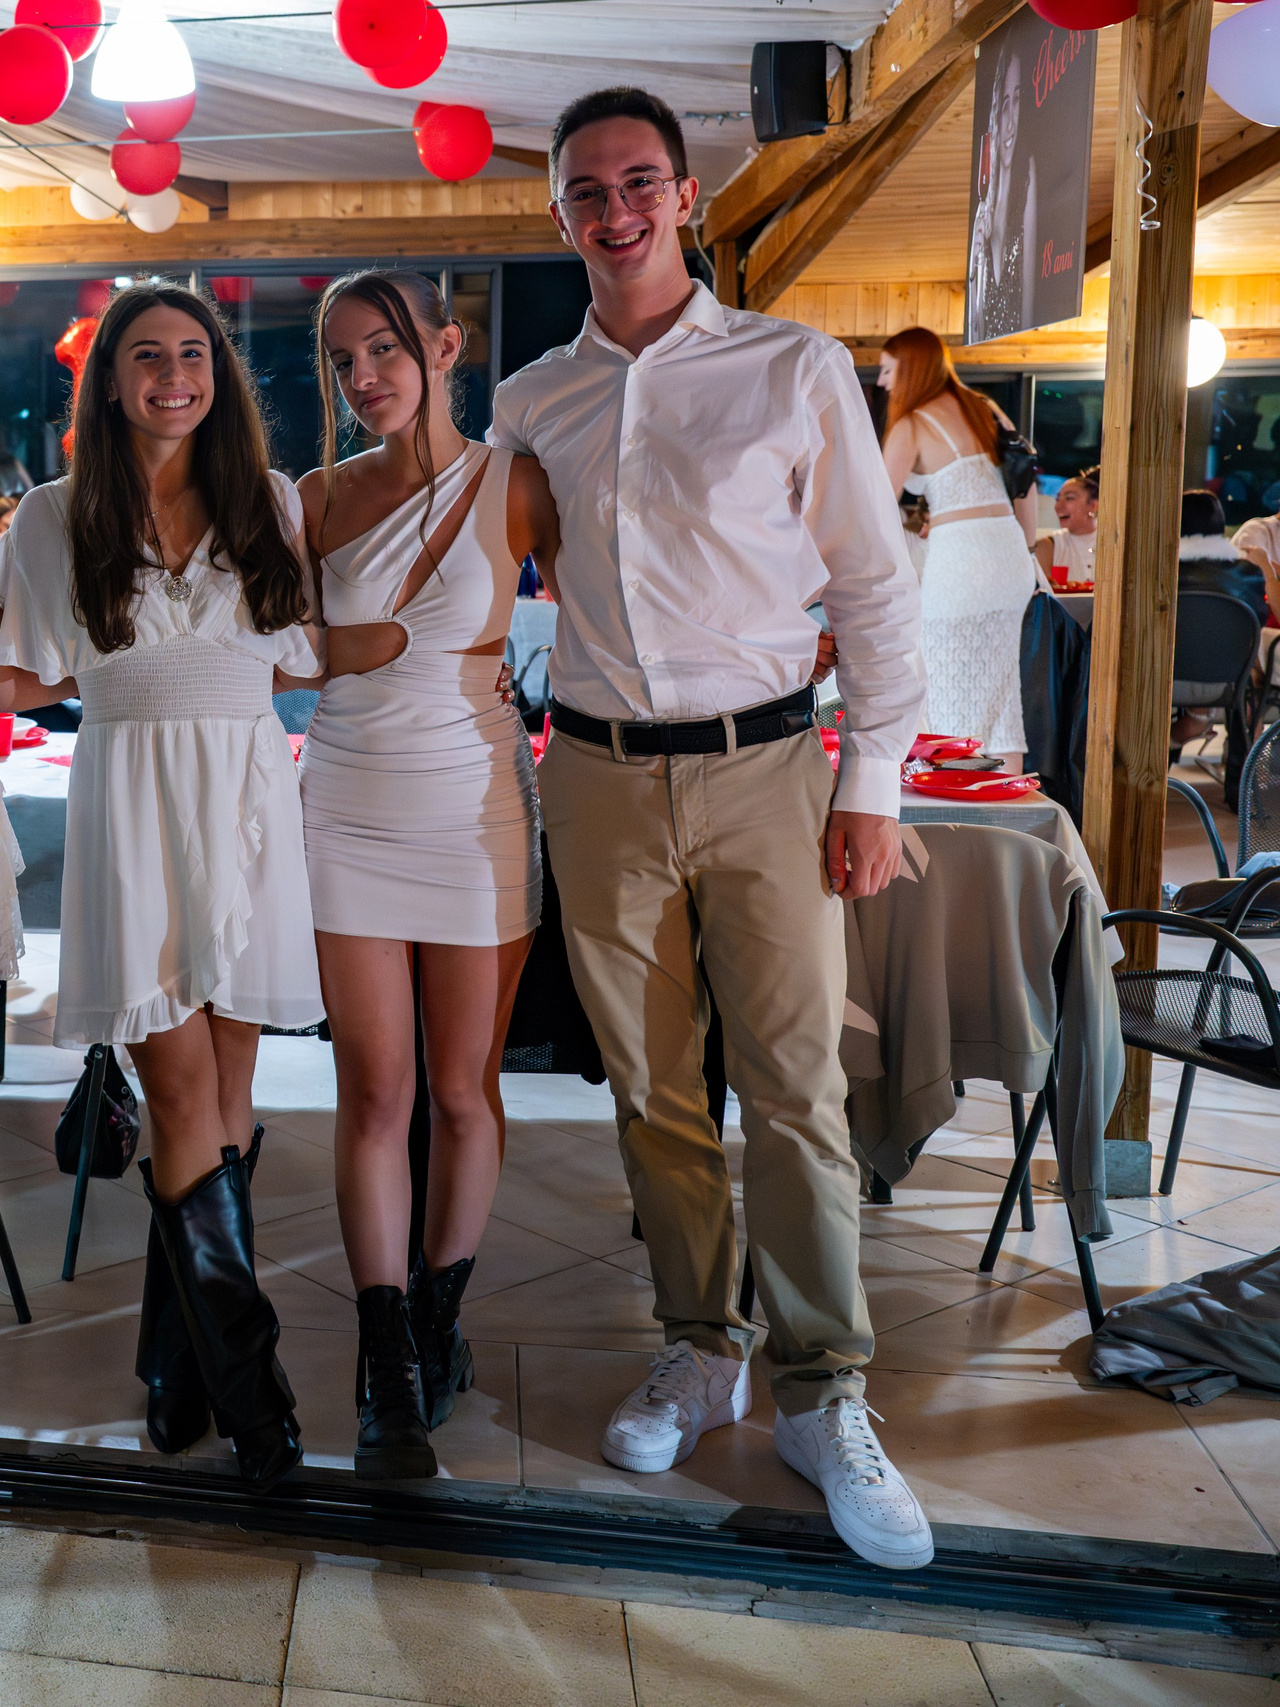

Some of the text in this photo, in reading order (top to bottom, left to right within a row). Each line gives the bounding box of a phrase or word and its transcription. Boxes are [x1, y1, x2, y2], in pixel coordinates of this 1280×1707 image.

[1032, 29, 1086, 108] Cheers
[1041, 239, 1075, 279] 18 anni
